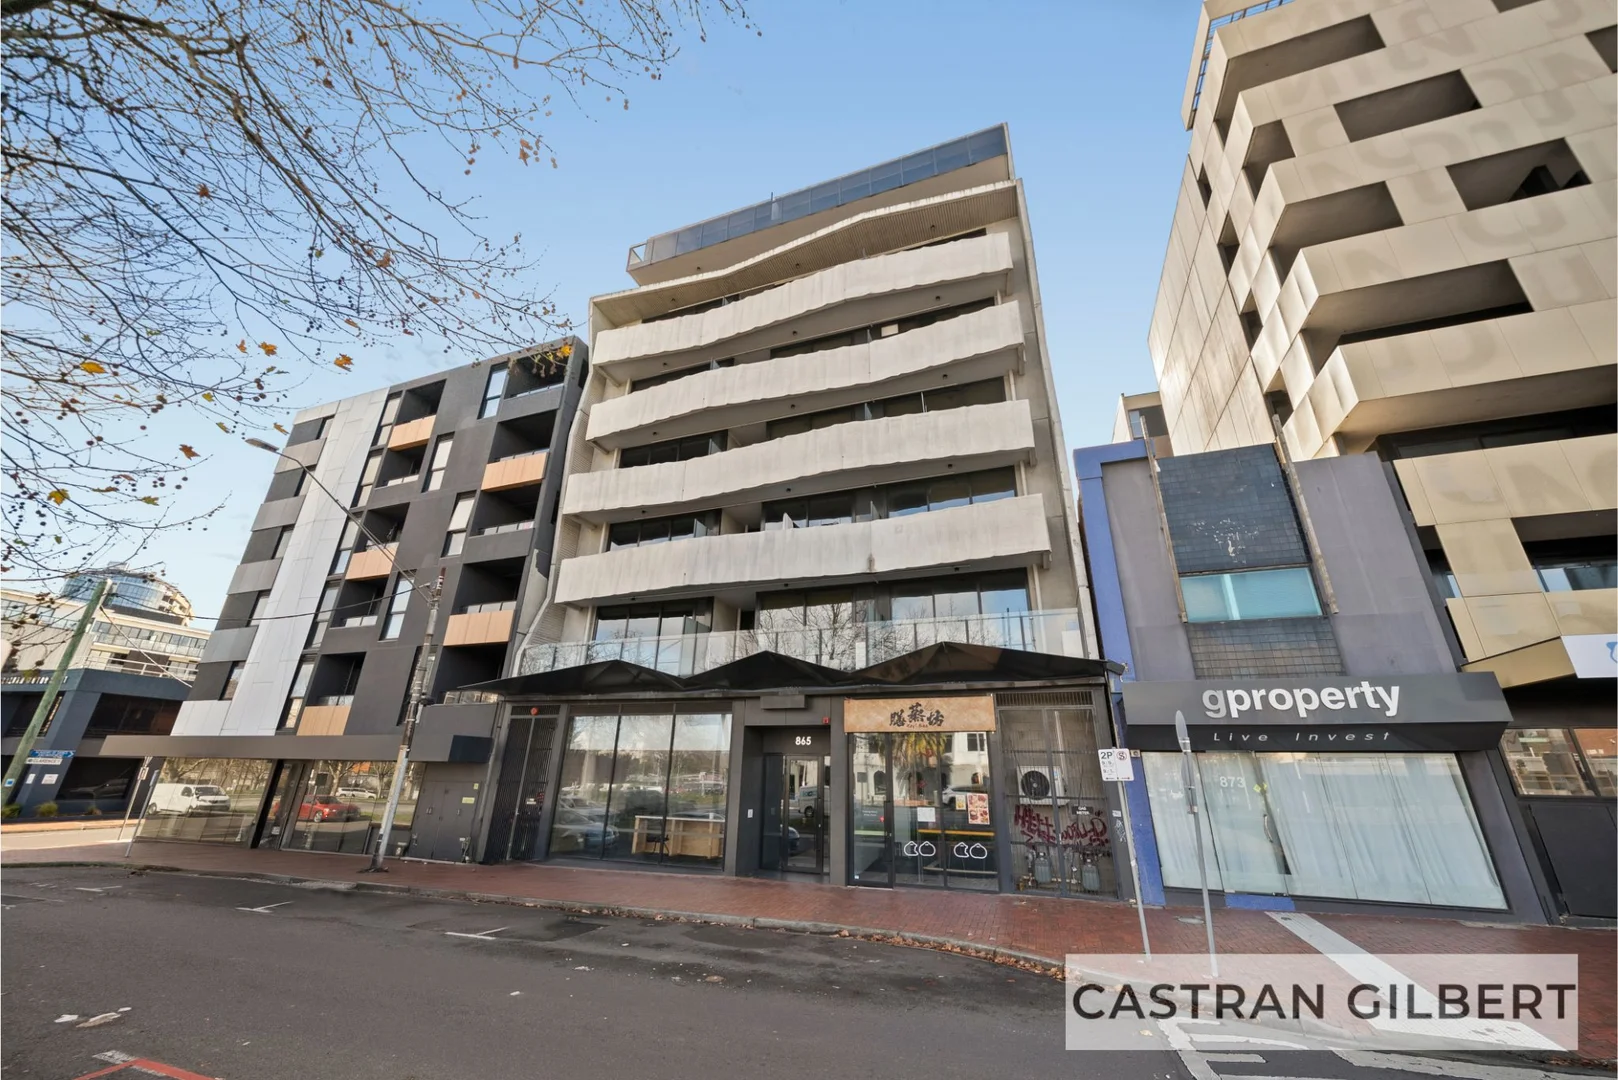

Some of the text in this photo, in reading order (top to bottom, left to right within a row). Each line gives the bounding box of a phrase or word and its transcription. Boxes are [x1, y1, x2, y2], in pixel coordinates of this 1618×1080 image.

[1202, 681, 1400, 719] gproperty
[795, 736, 812, 746] 865
[1213, 731, 1390, 742] Live Invest
[1100, 751, 1113, 760] 2P
[1219, 776, 1246, 788] 873
